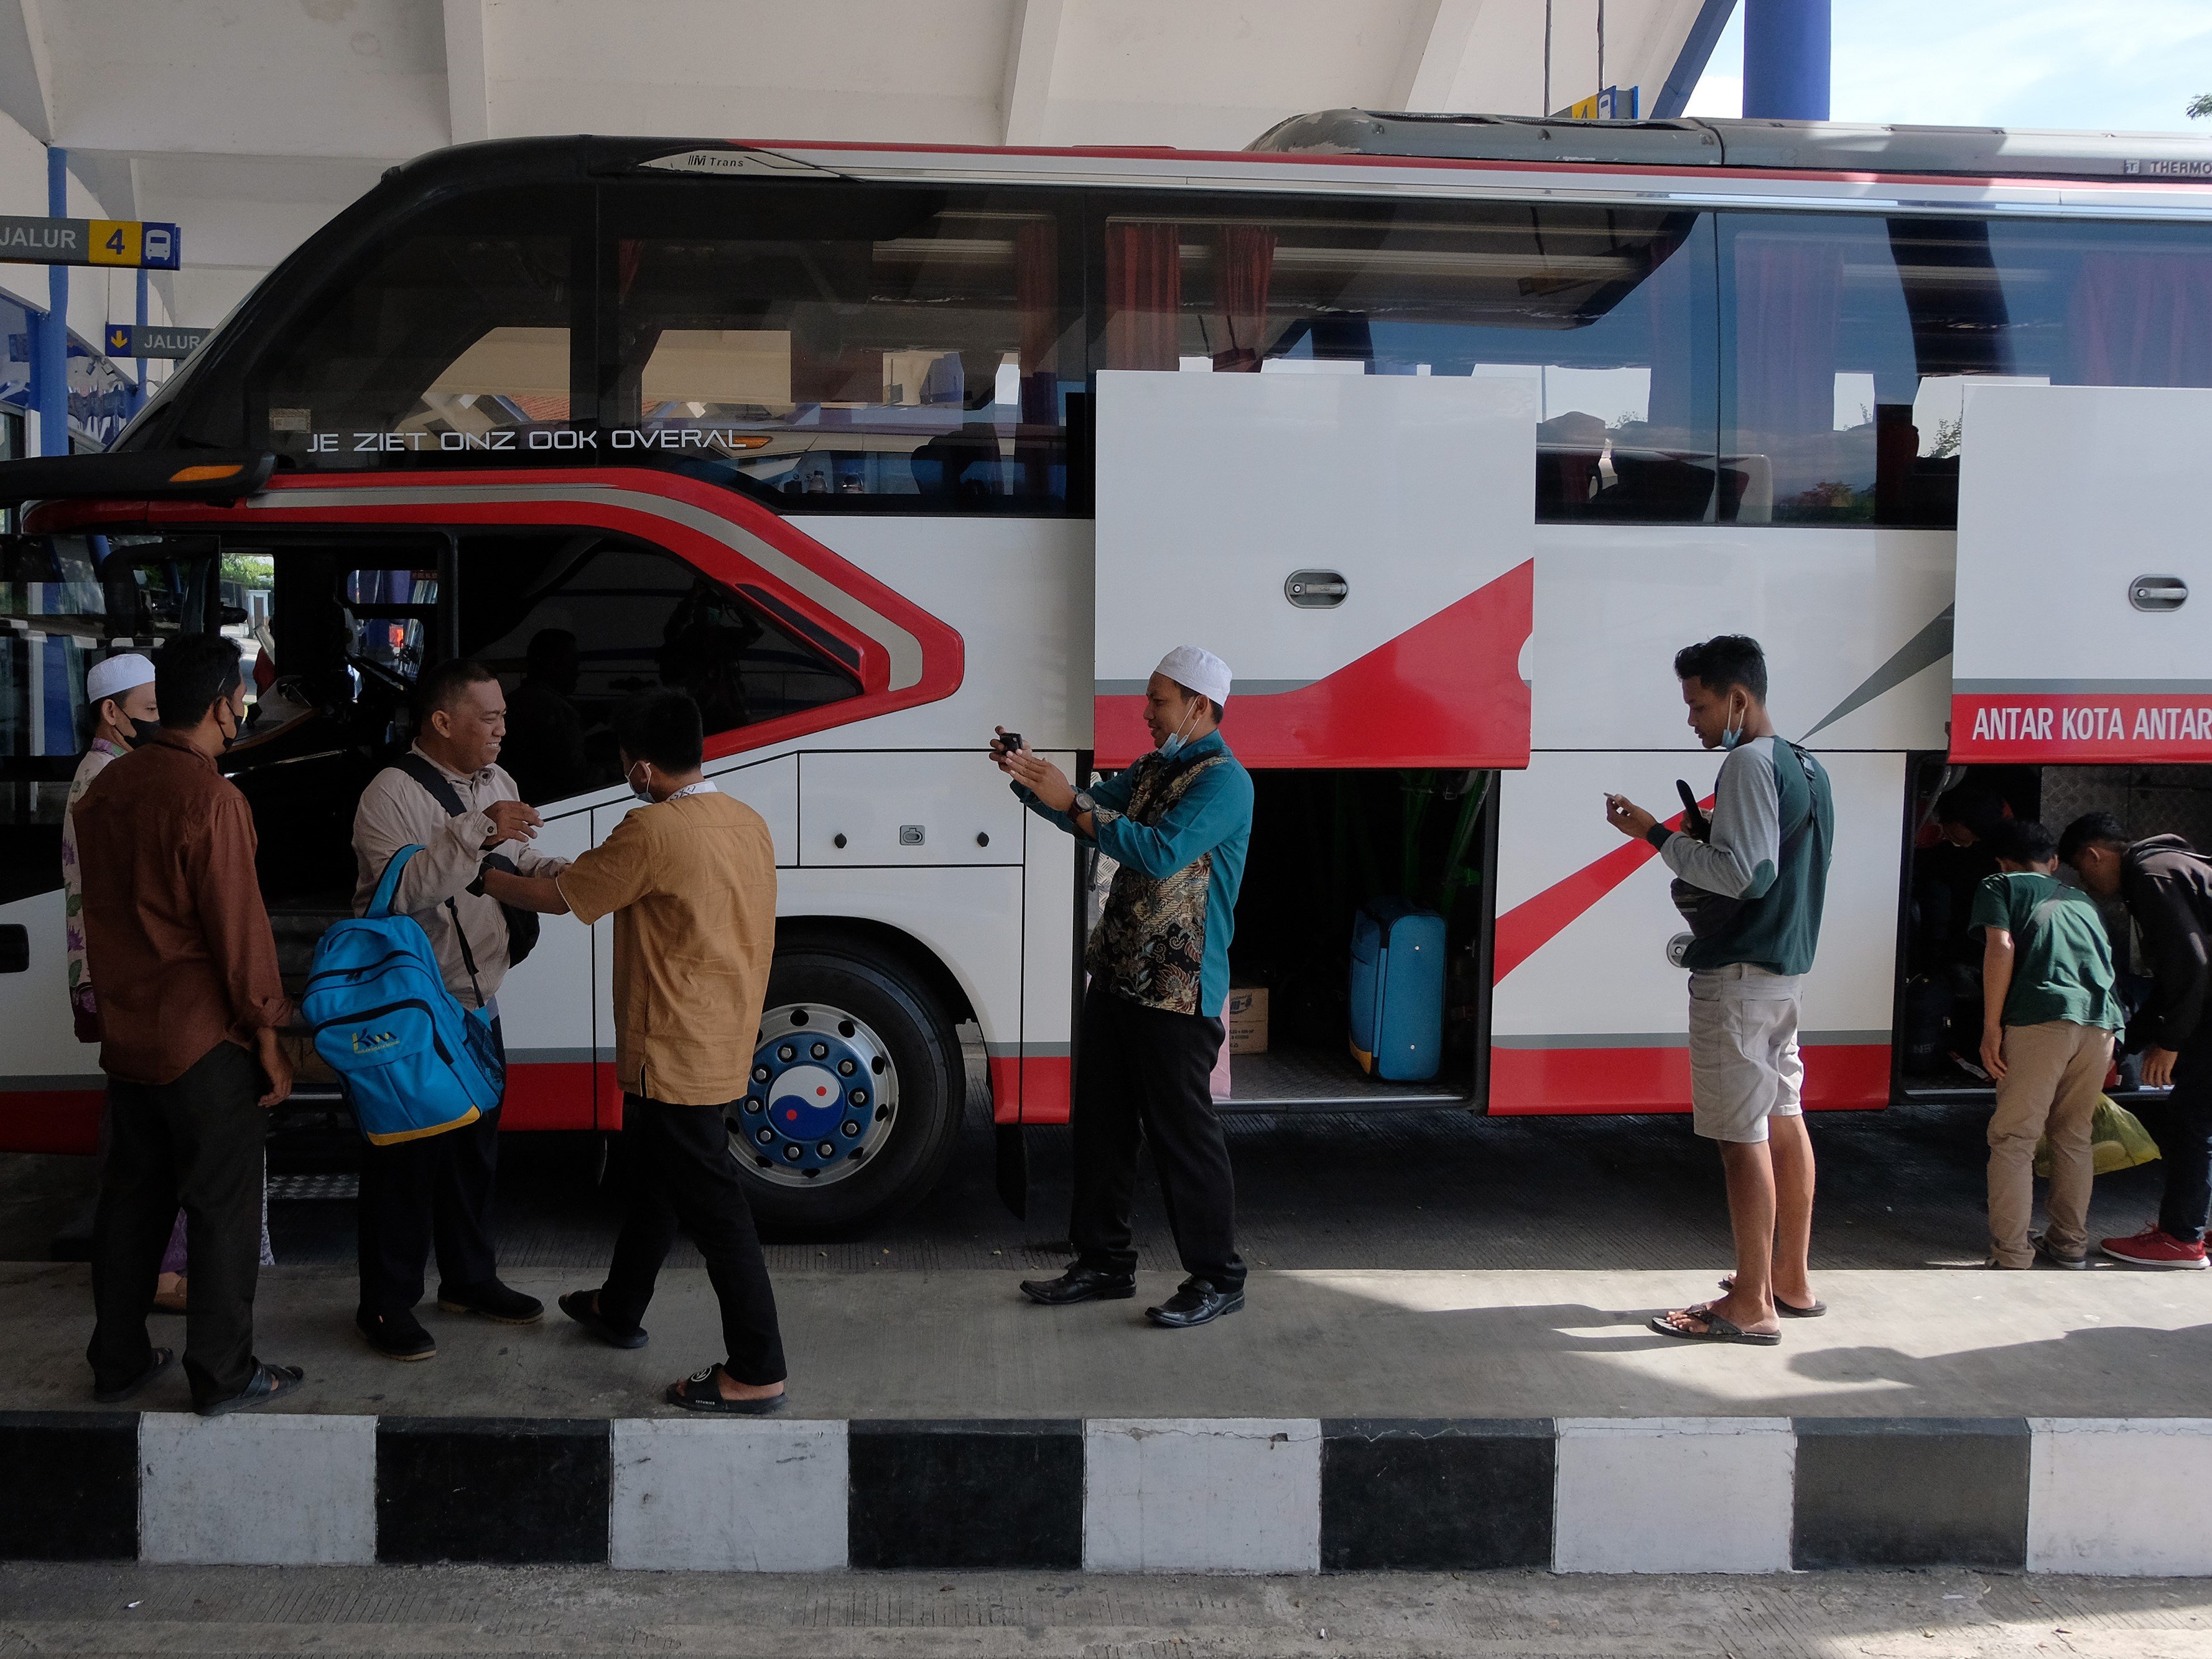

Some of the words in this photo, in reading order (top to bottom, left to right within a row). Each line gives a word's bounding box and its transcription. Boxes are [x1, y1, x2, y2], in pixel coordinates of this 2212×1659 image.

[710, 157, 744, 167] Trans
[2150, 160, 2212, 174] THERMO
[0, 227, 77, 249] JALUR
[106, 229, 125, 254] 4
[144, 335, 200, 350] JALUR
[307, 433, 339, 452] JE
[353, 432, 427, 452] ZIET
[441, 431, 516, 450] ONZ
[529, 430, 598, 449] OOK
[611, 428, 747, 448] OVERAL
[1972, 708, 2053, 740] ANTAR
[2061, 708, 2124, 740] KOTA
[2132, 708, 2212, 740] ANTAR
